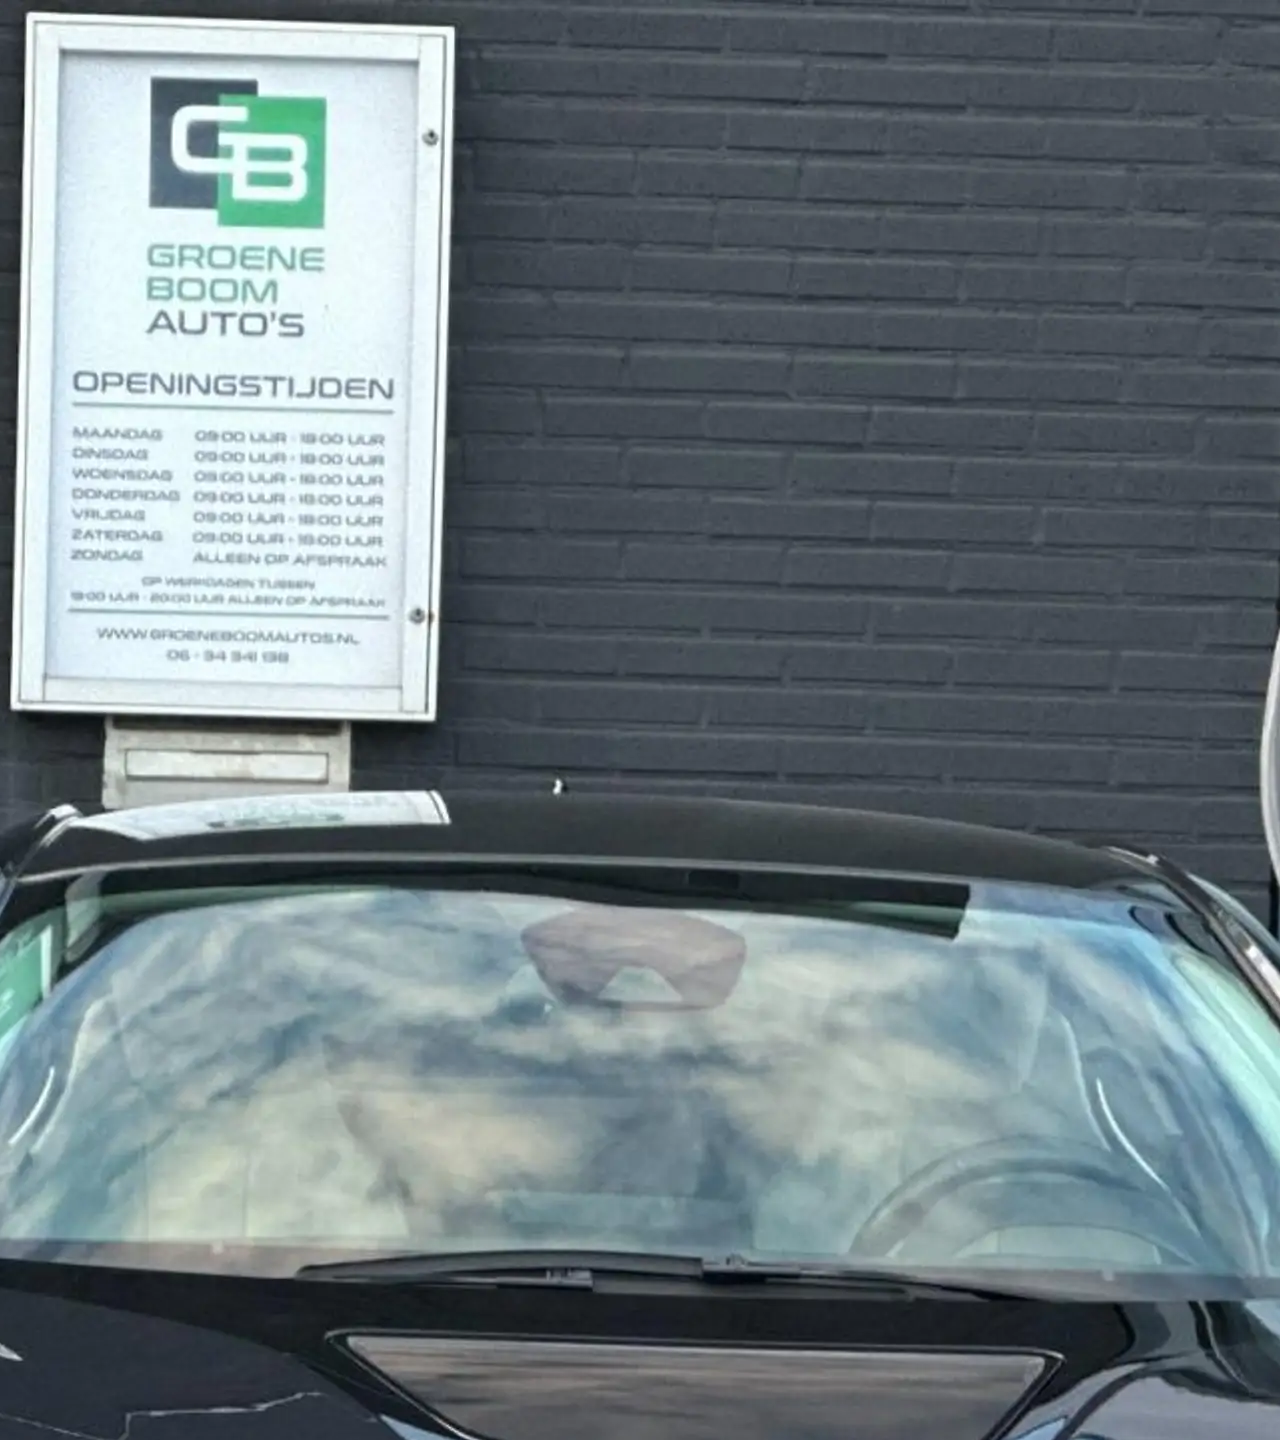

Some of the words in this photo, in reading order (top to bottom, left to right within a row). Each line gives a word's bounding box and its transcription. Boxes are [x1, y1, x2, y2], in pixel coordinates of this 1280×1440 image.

[147, 244, 325, 271] GROENE
[146, 277, 279, 304] BOOM
[146, 310, 305, 337] AUTO'S
[72, 370, 394, 400] OPENINGSTIJDEN
[72, 426, 163, 441] MAANDAG
[249, 431, 287, 444] UUR
[347, 433, 385, 447] UUR
[72, 447, 148, 460] DINSDAG
[248, 451, 287, 464] UUR
[346, 453, 385, 466] UUR
[72, 467, 173, 481] WOENSDAG
[248, 471, 286, 485] UUR
[346, 474, 384, 487] UUR
[72, 487, 180, 501] DONDERDAG
[247, 492, 285, 505] UUR
[346, 494, 384, 507] UUR
[72, 507, 146, 521] VRIJDAG
[247, 512, 285, 525] UUR
[345, 515, 384, 527] UUR
[71, 528, 163, 541] ZATERDAG
[247, 532, 284, 545] UUR
[344, 535, 383, 548] UUR
[70, 548, 143, 561] ZONDAG
[193, 551, 260, 565] ALLEEN
[264, 553, 289, 564] OP
[293, 553, 387, 567] AFSPRAAK
